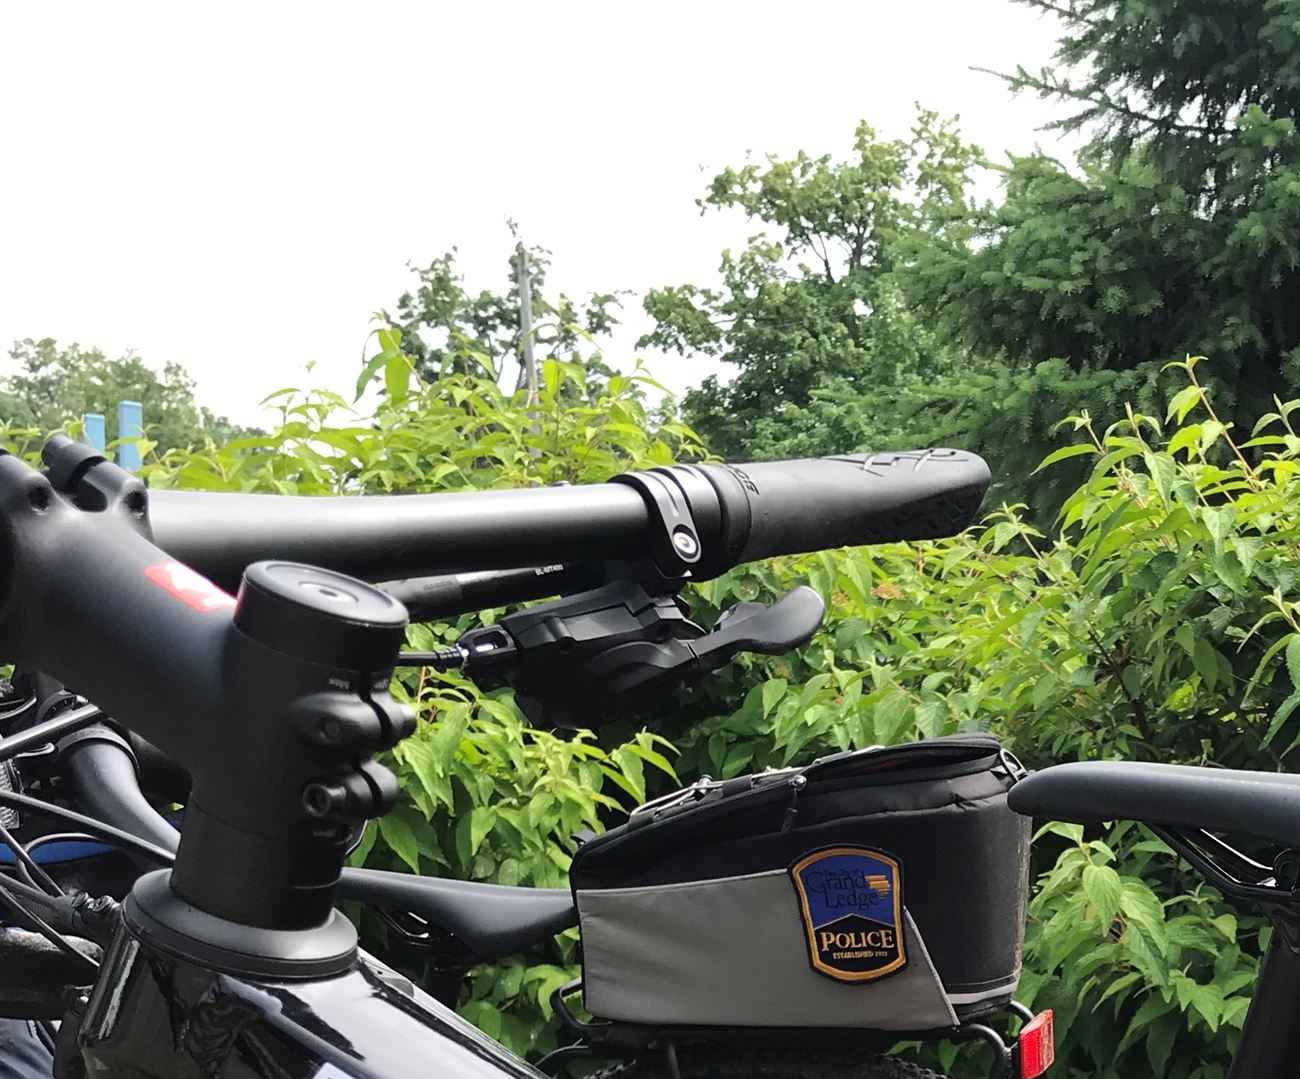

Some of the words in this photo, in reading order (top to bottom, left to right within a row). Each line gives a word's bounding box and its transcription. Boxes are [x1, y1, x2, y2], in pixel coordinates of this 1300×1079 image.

[806, 870, 866, 893] Grand
[825, 888, 878, 910] Ledge
[821, 930, 894, 951] POLICE
